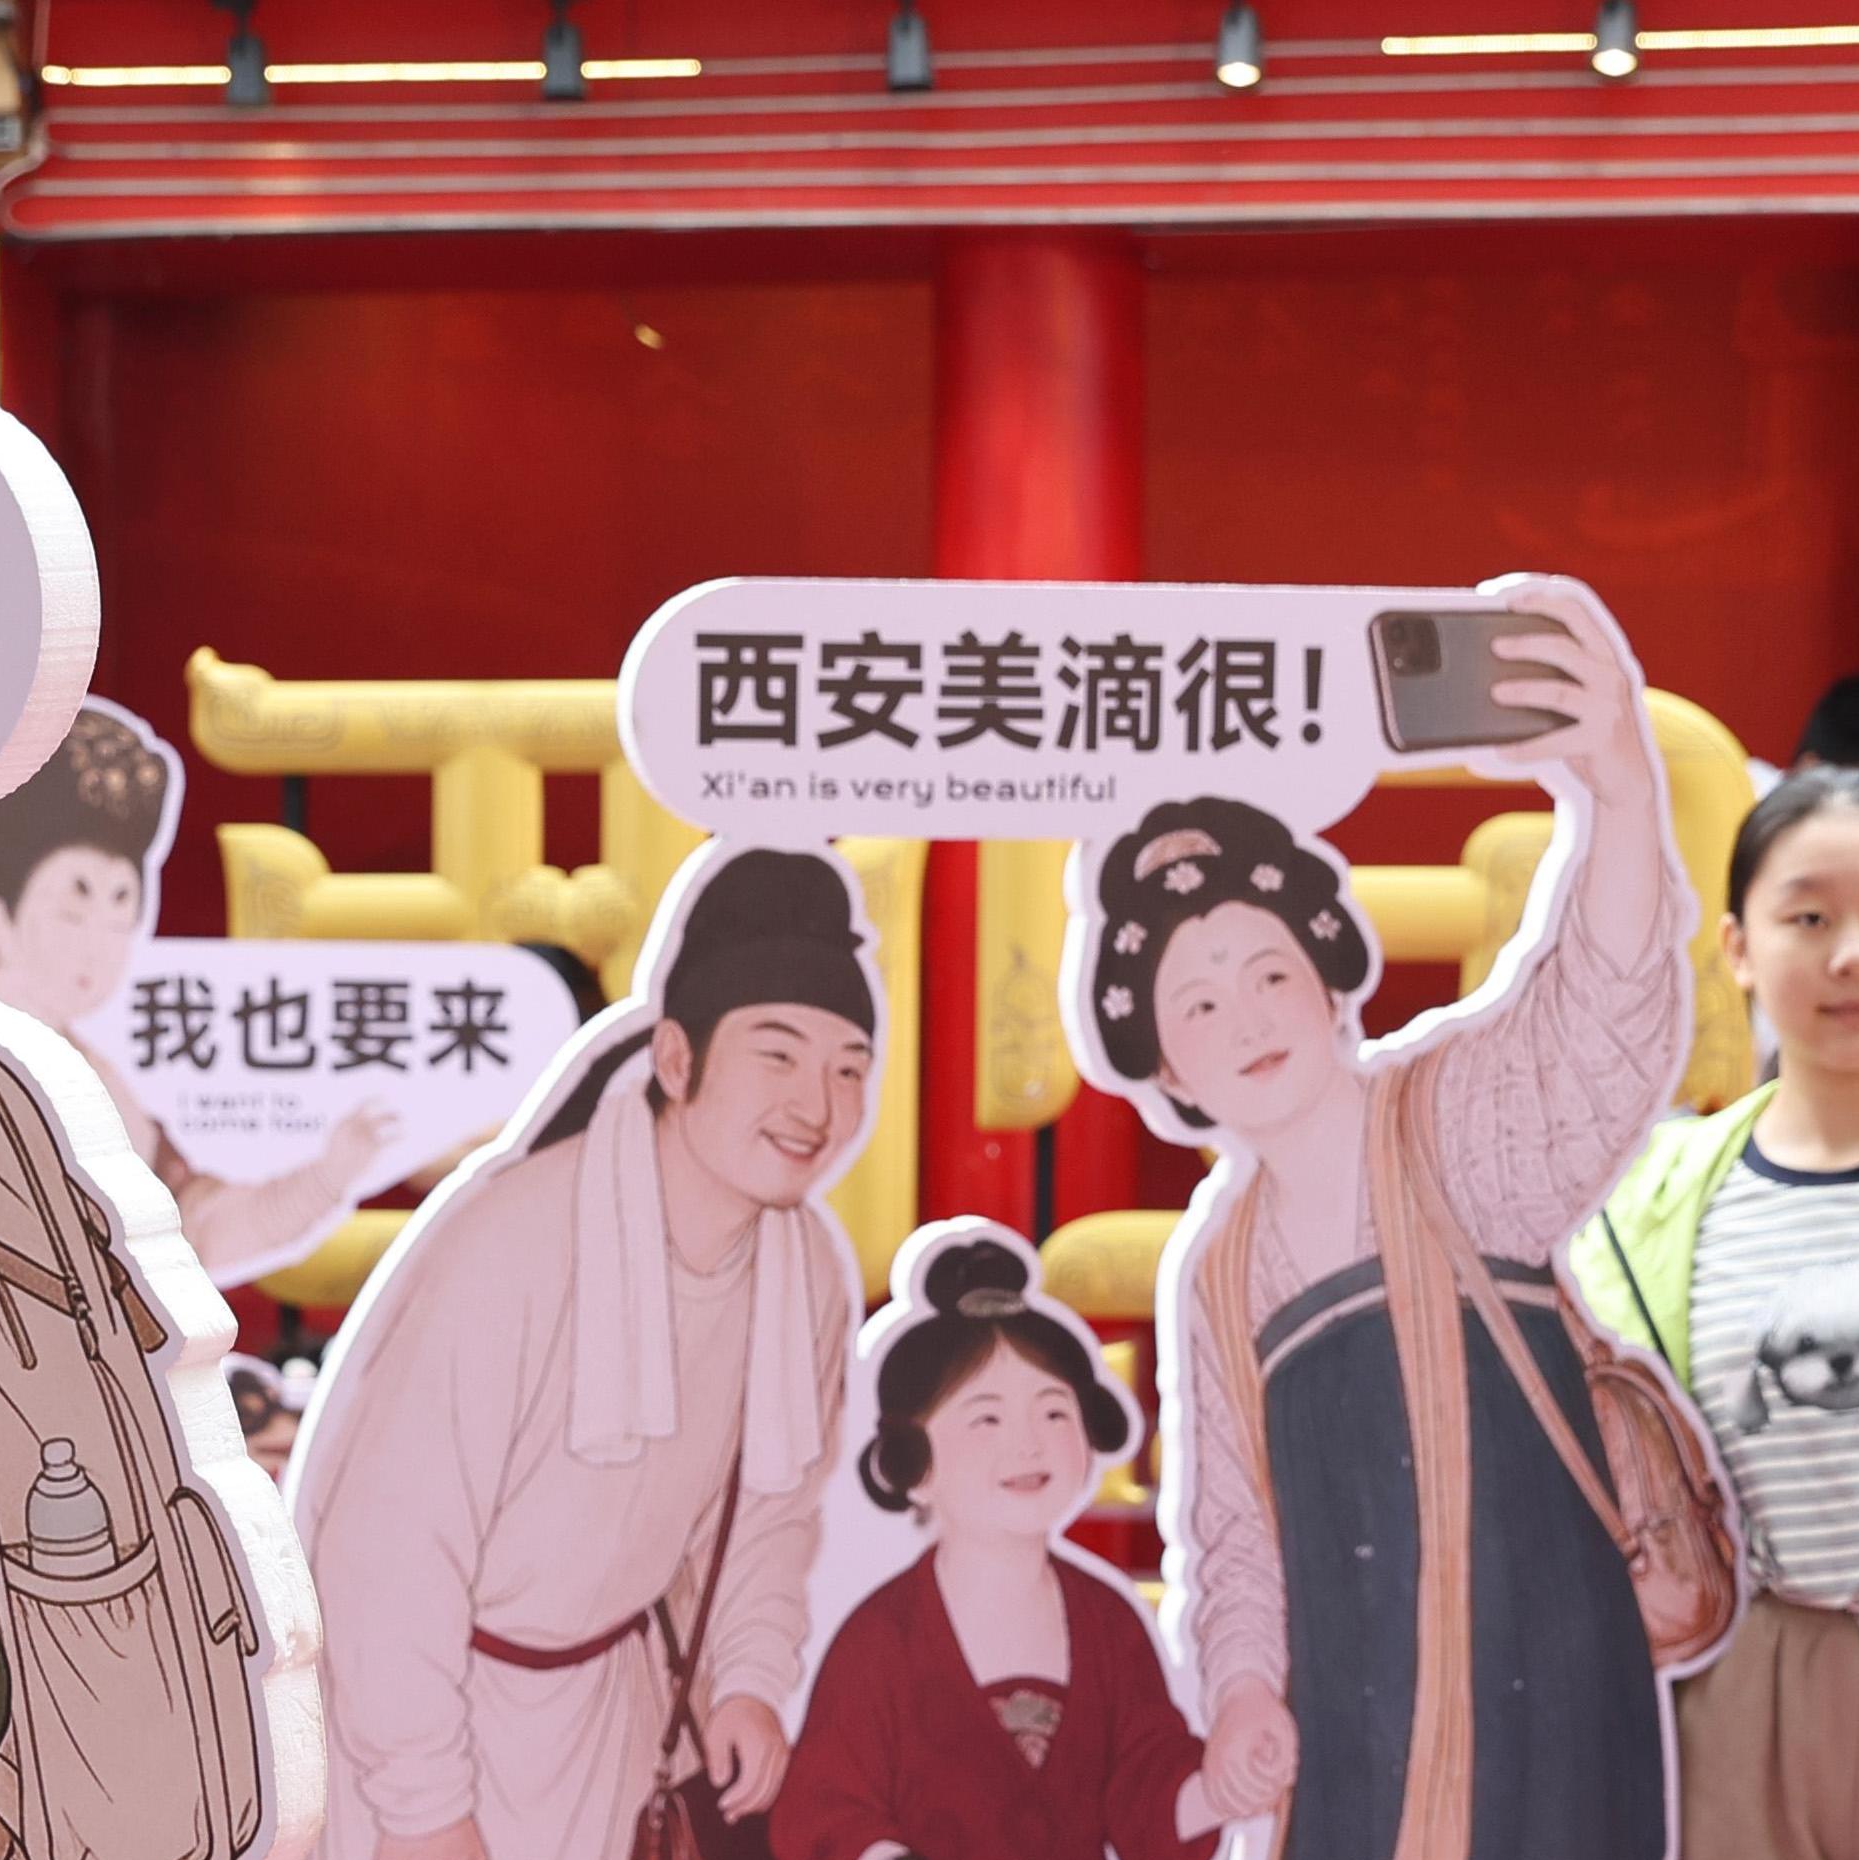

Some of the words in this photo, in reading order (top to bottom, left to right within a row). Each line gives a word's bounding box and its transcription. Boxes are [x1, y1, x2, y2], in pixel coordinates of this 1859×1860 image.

[694, 630, 1326, 754] 西安美滴很!
[700, 771, 797, 800] Xi'an
[808, 771, 839, 800] is
[849, 777, 936, 808] very
[945, 773, 1117, 801] beautiful
[131, 971, 509, 1074] 我也要来
